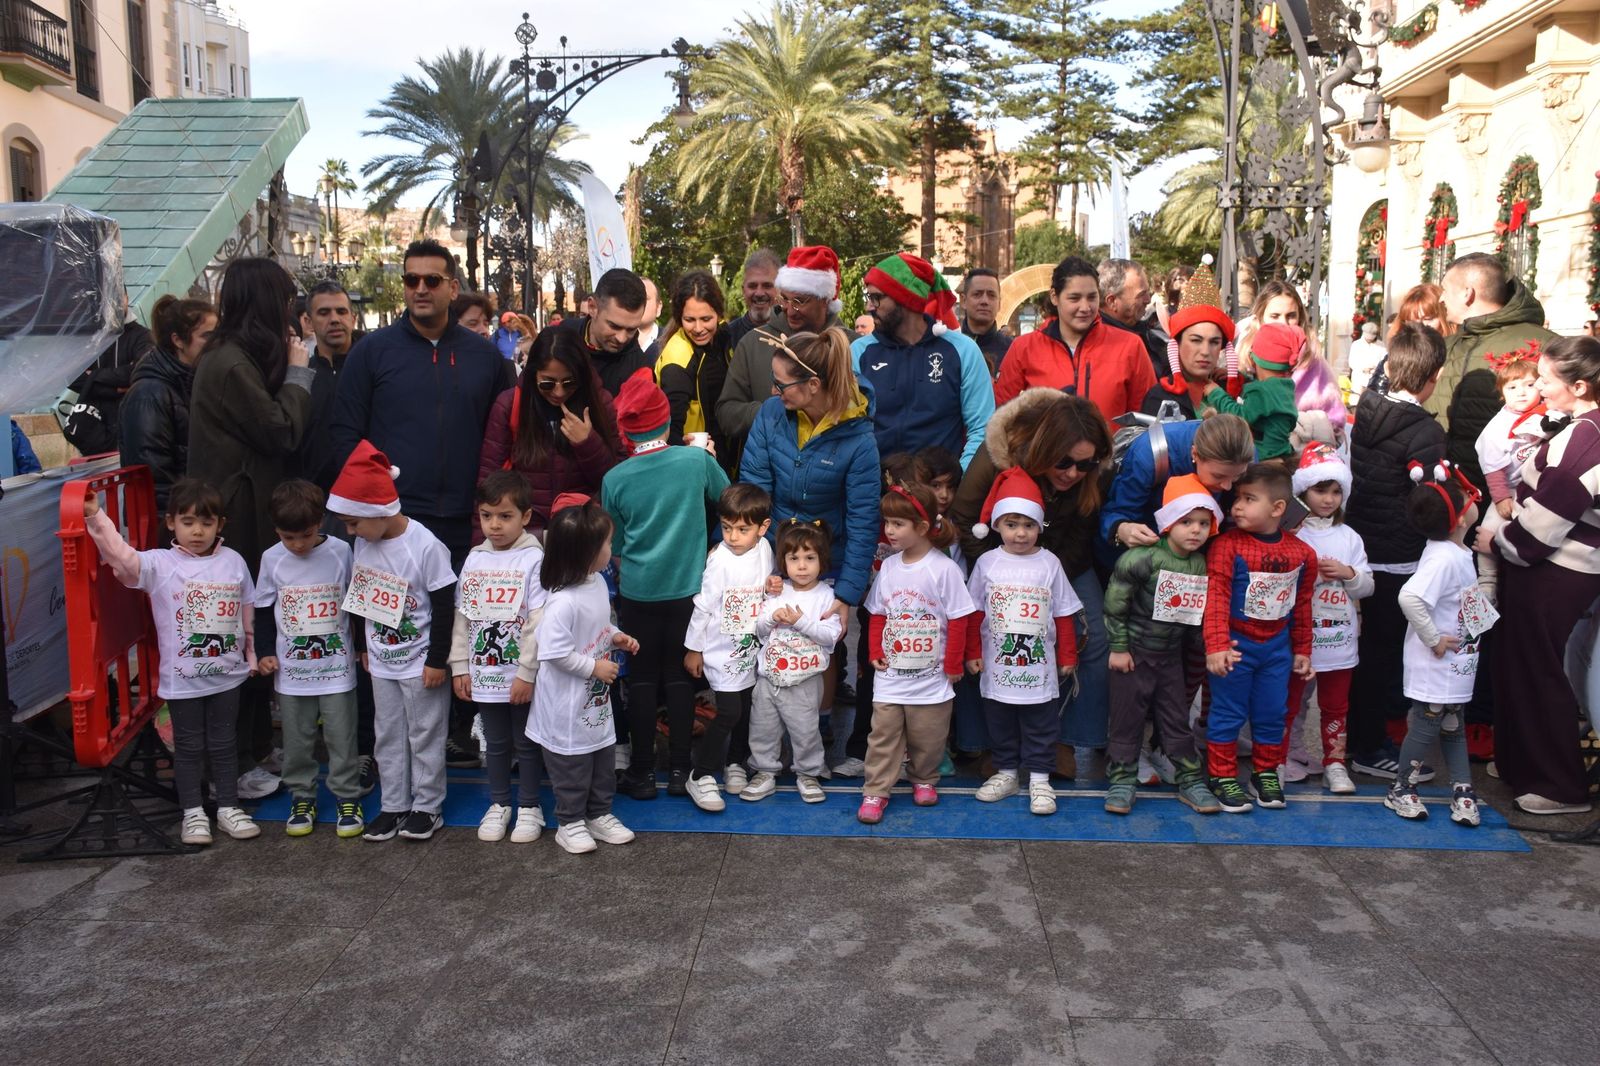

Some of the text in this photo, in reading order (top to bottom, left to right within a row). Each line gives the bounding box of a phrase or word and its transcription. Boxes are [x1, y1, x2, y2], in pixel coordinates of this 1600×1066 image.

[371, 588, 399, 610] 293
[485, 587, 518, 604] 127
[1181, 592, 1204, 608] 556
[1319, 589, 1348, 605] 464
[306, 601, 338, 619] 123
[1019, 602, 1040, 619] 32
[901, 637, 934, 653] 363
[381, 648, 410, 660] Bruno
[194, 661, 224, 675] Vera
[789, 654, 820, 671] 364
[1001, 670, 1040, 685] Rodrigo
